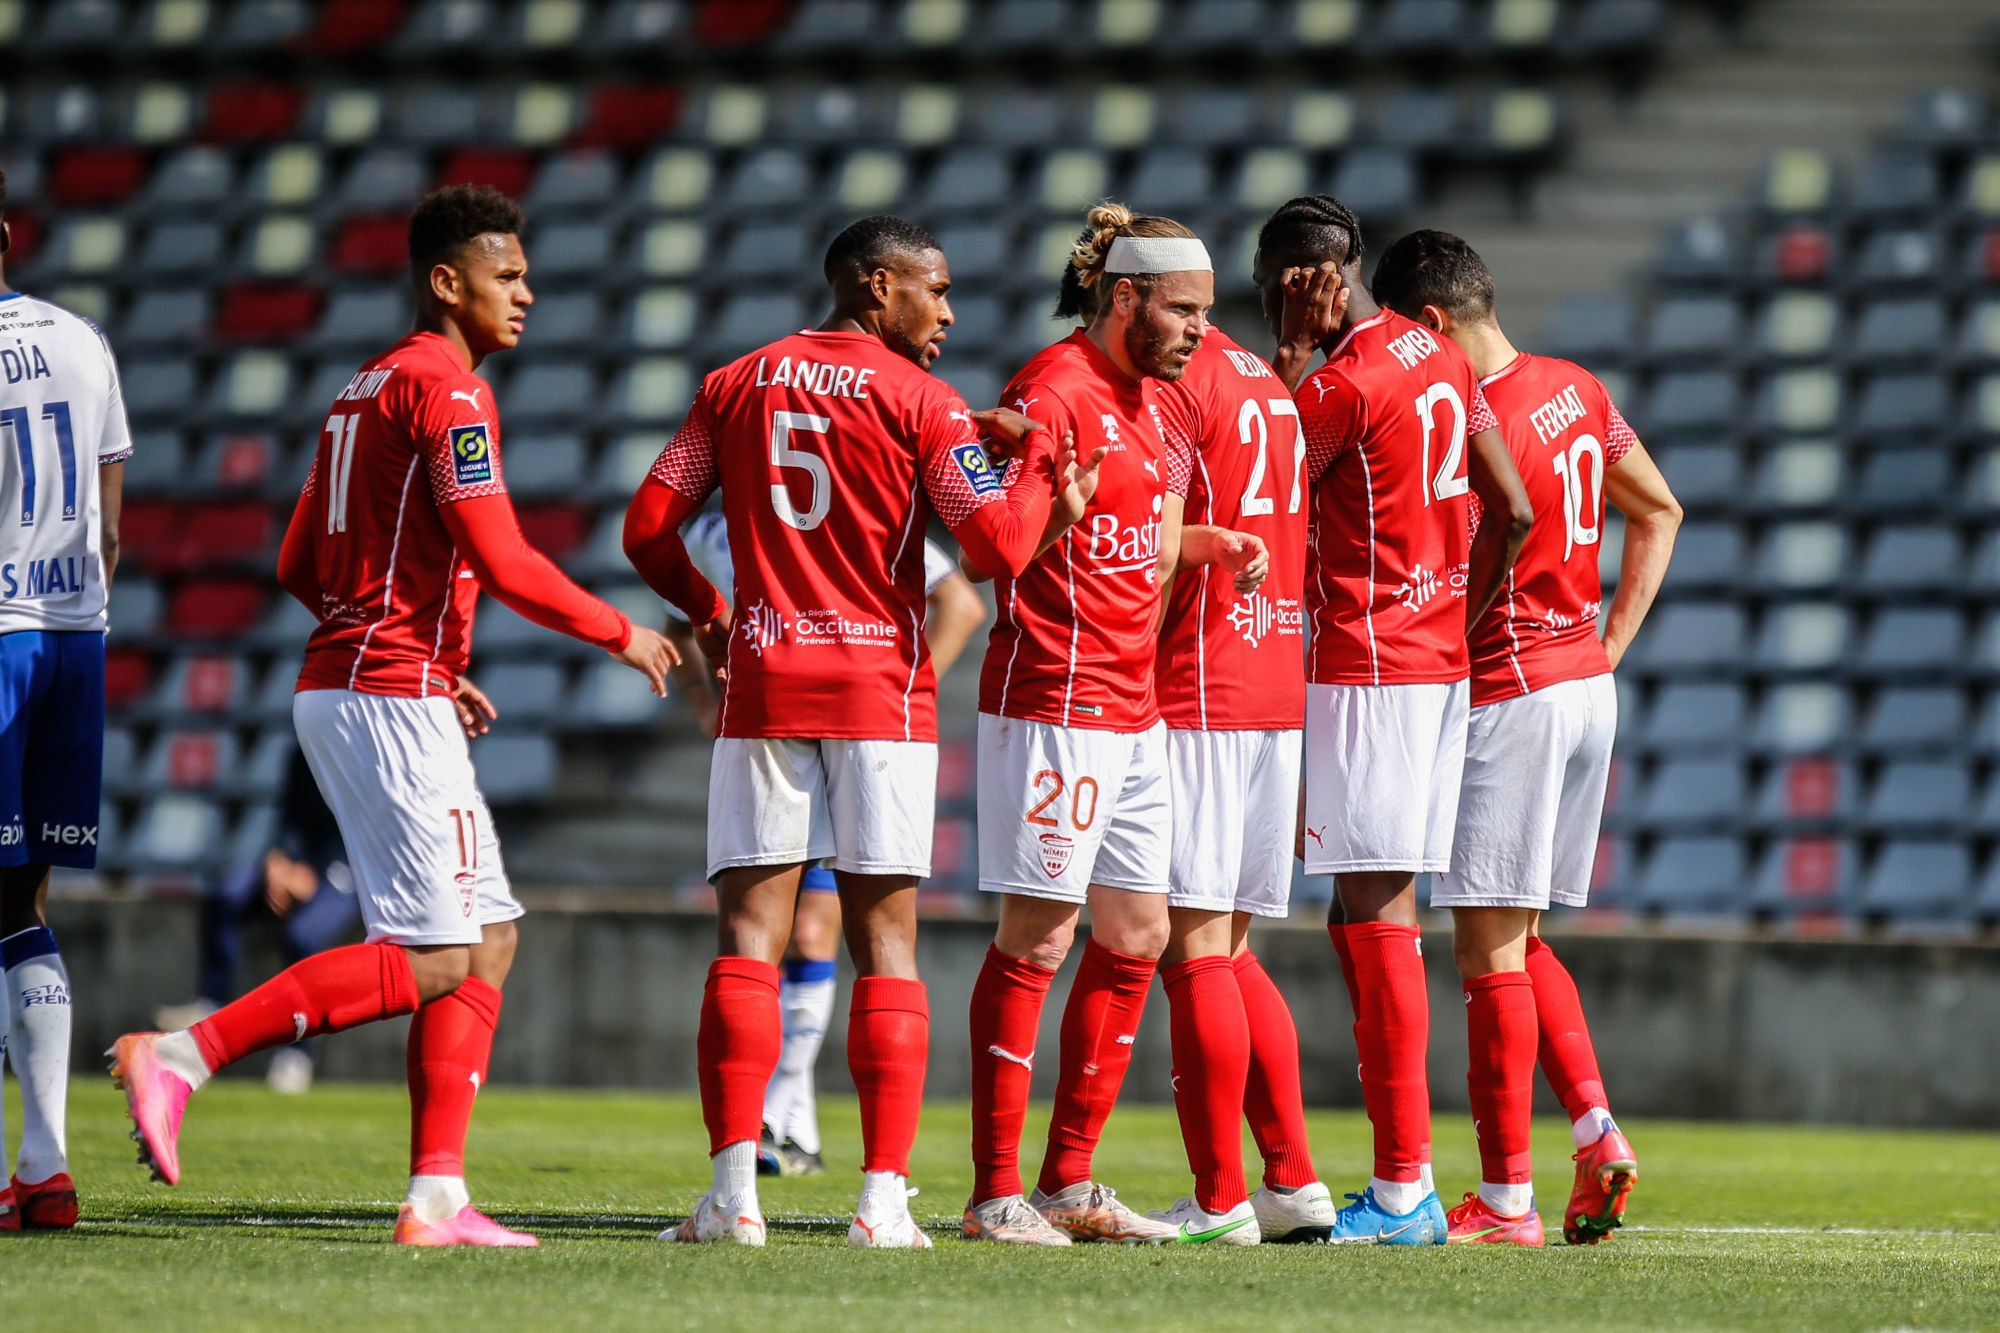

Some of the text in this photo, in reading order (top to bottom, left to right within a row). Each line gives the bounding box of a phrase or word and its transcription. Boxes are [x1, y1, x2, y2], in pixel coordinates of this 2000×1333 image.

[755, 356, 877, 399] LANDRE
[1415, 381, 1469, 508] 12
[1529, 383, 1588, 446] FERHAT
[0, 401, 77, 527] 11
[325, 413, 360, 535] 11
[460, 464, 483, 472] LIGUE
[770, 410, 831, 531] 5
[1238, 398, 1306, 517] 27
[1552, 433, 1605, 563] 10
[796, 617, 897, 637] Occitanie
[796, 636, 835, 646] Pyrénées
[842, 636, 895, 648] Méditerranée
[808, 609, 838, 618] Région
[1024, 769, 1099, 831] 20
[42, 822, 98, 846] Hex
[448, 809, 477, 870] 11
